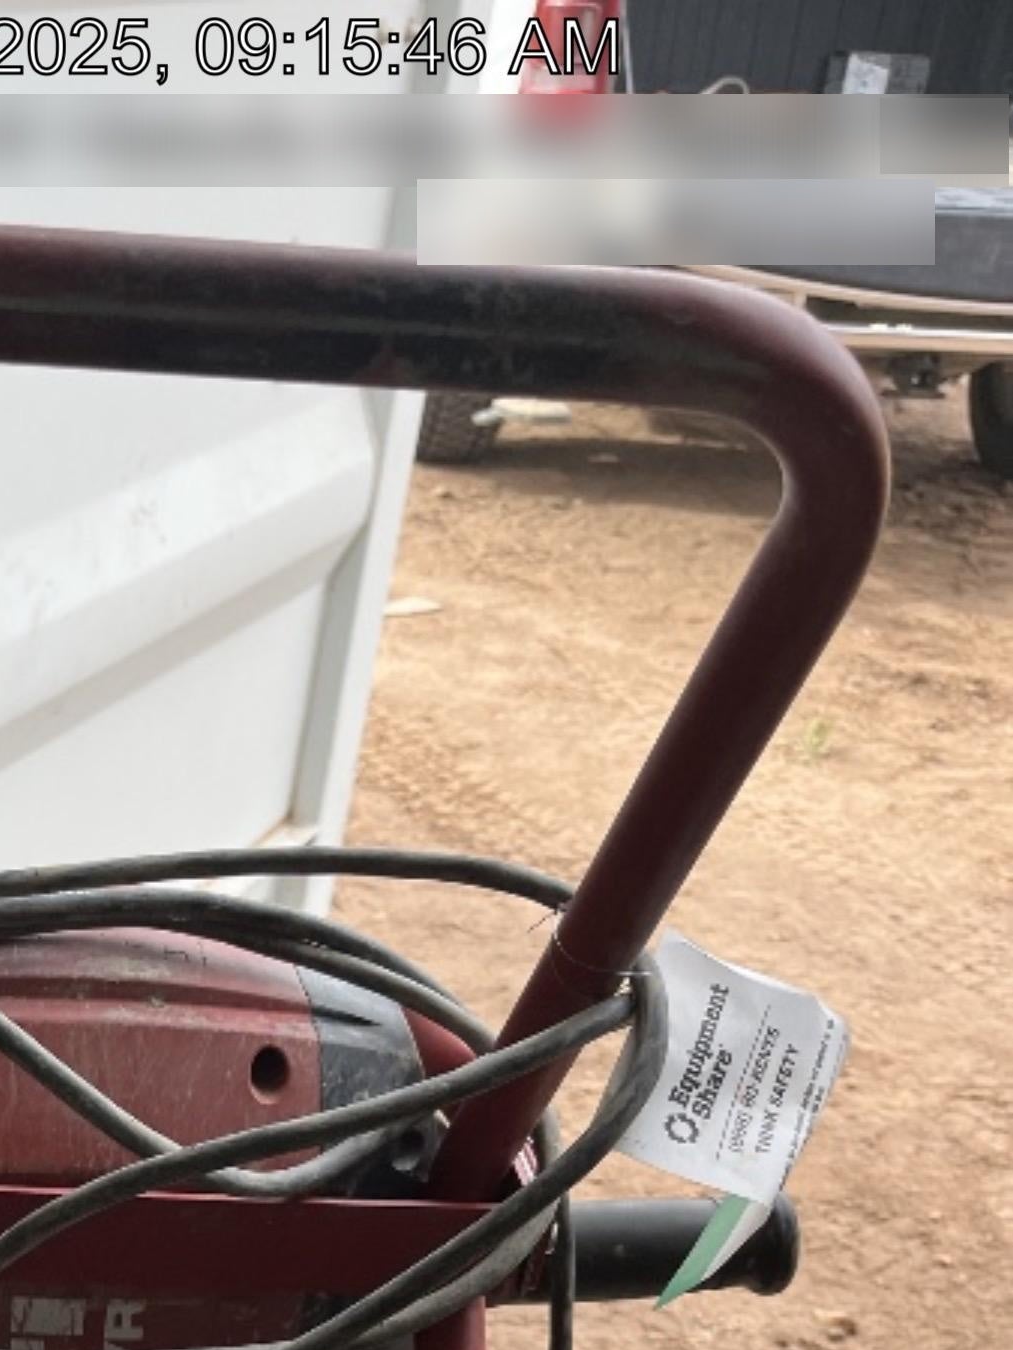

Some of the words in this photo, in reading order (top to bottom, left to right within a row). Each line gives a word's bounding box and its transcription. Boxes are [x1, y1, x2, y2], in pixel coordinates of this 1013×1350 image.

[668, 983, 730, 1108] Equipment
[770, 1042, 799, 1108] SAFETY
[692, 1048, 732, 1120] Share
